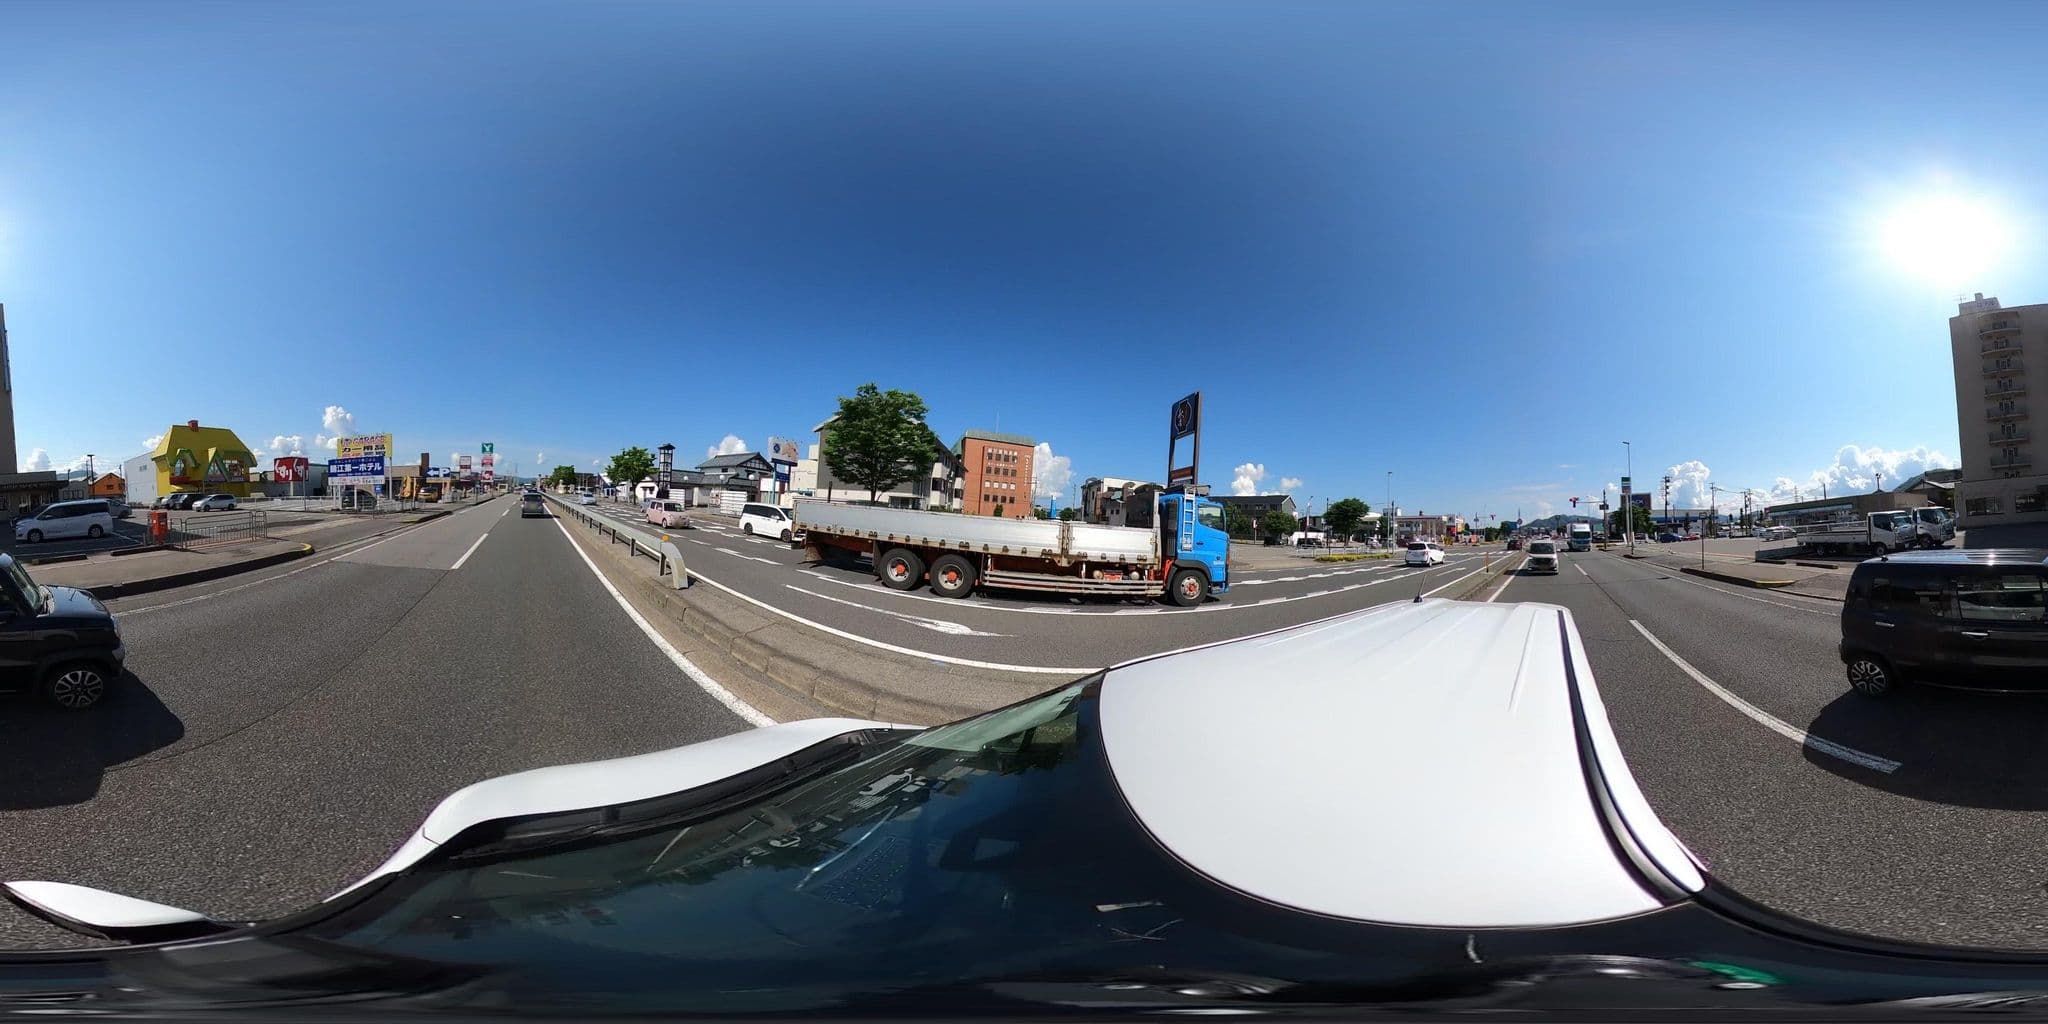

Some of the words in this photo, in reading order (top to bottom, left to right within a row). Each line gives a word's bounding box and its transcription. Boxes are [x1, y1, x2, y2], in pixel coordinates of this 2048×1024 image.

[342, 445, 386, 453] カー用品
[275, 459, 293, 481] くすり
[439, 468, 450, 477] P
